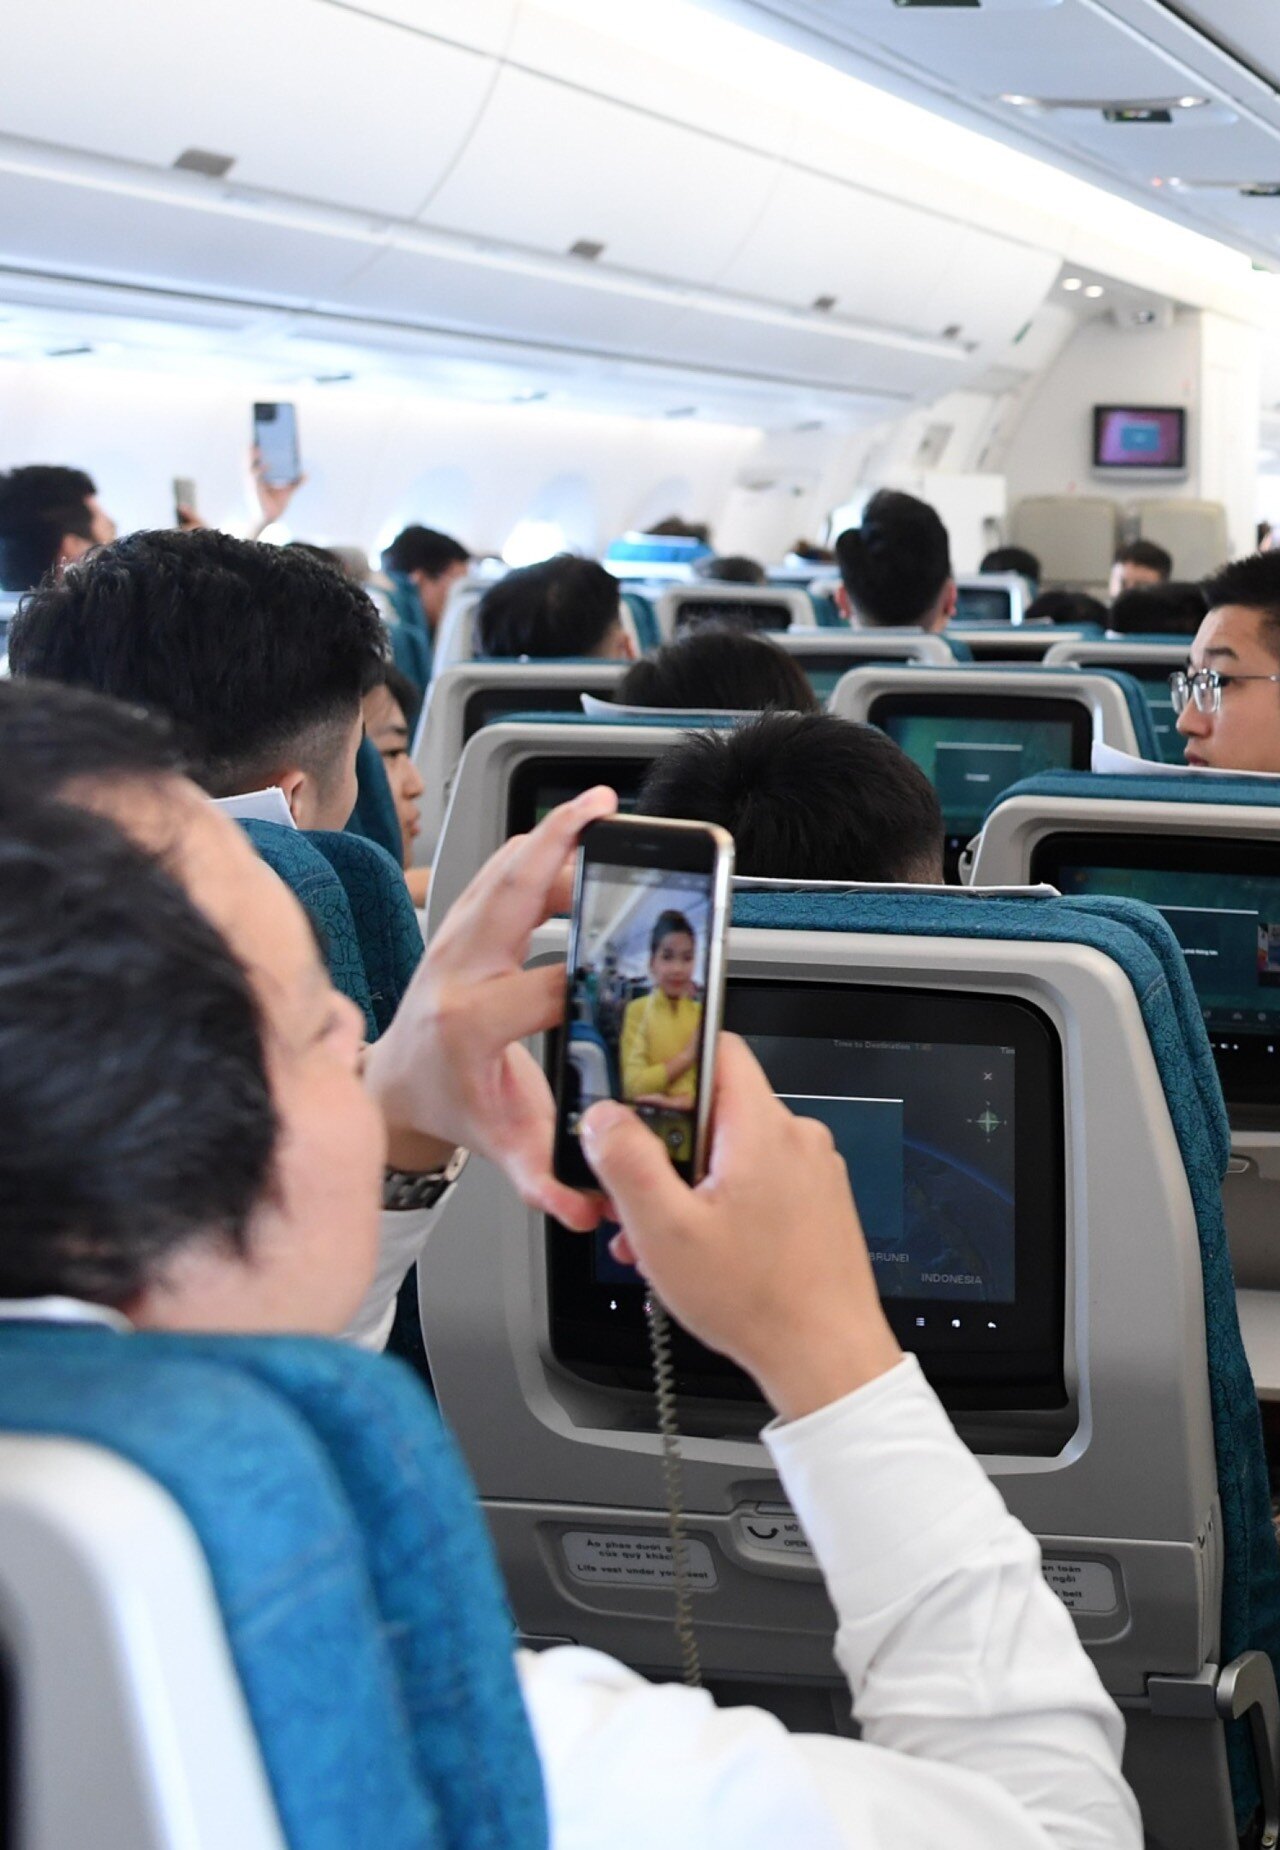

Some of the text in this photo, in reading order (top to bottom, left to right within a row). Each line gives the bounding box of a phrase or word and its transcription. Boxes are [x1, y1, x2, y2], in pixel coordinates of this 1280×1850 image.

[868, 1252, 909, 1263] BRUNEI
[920, 1272, 983, 1285] INDONESIA
[577, 1563, 597, 1572] Life
[626, 1567, 655, 1575] under
